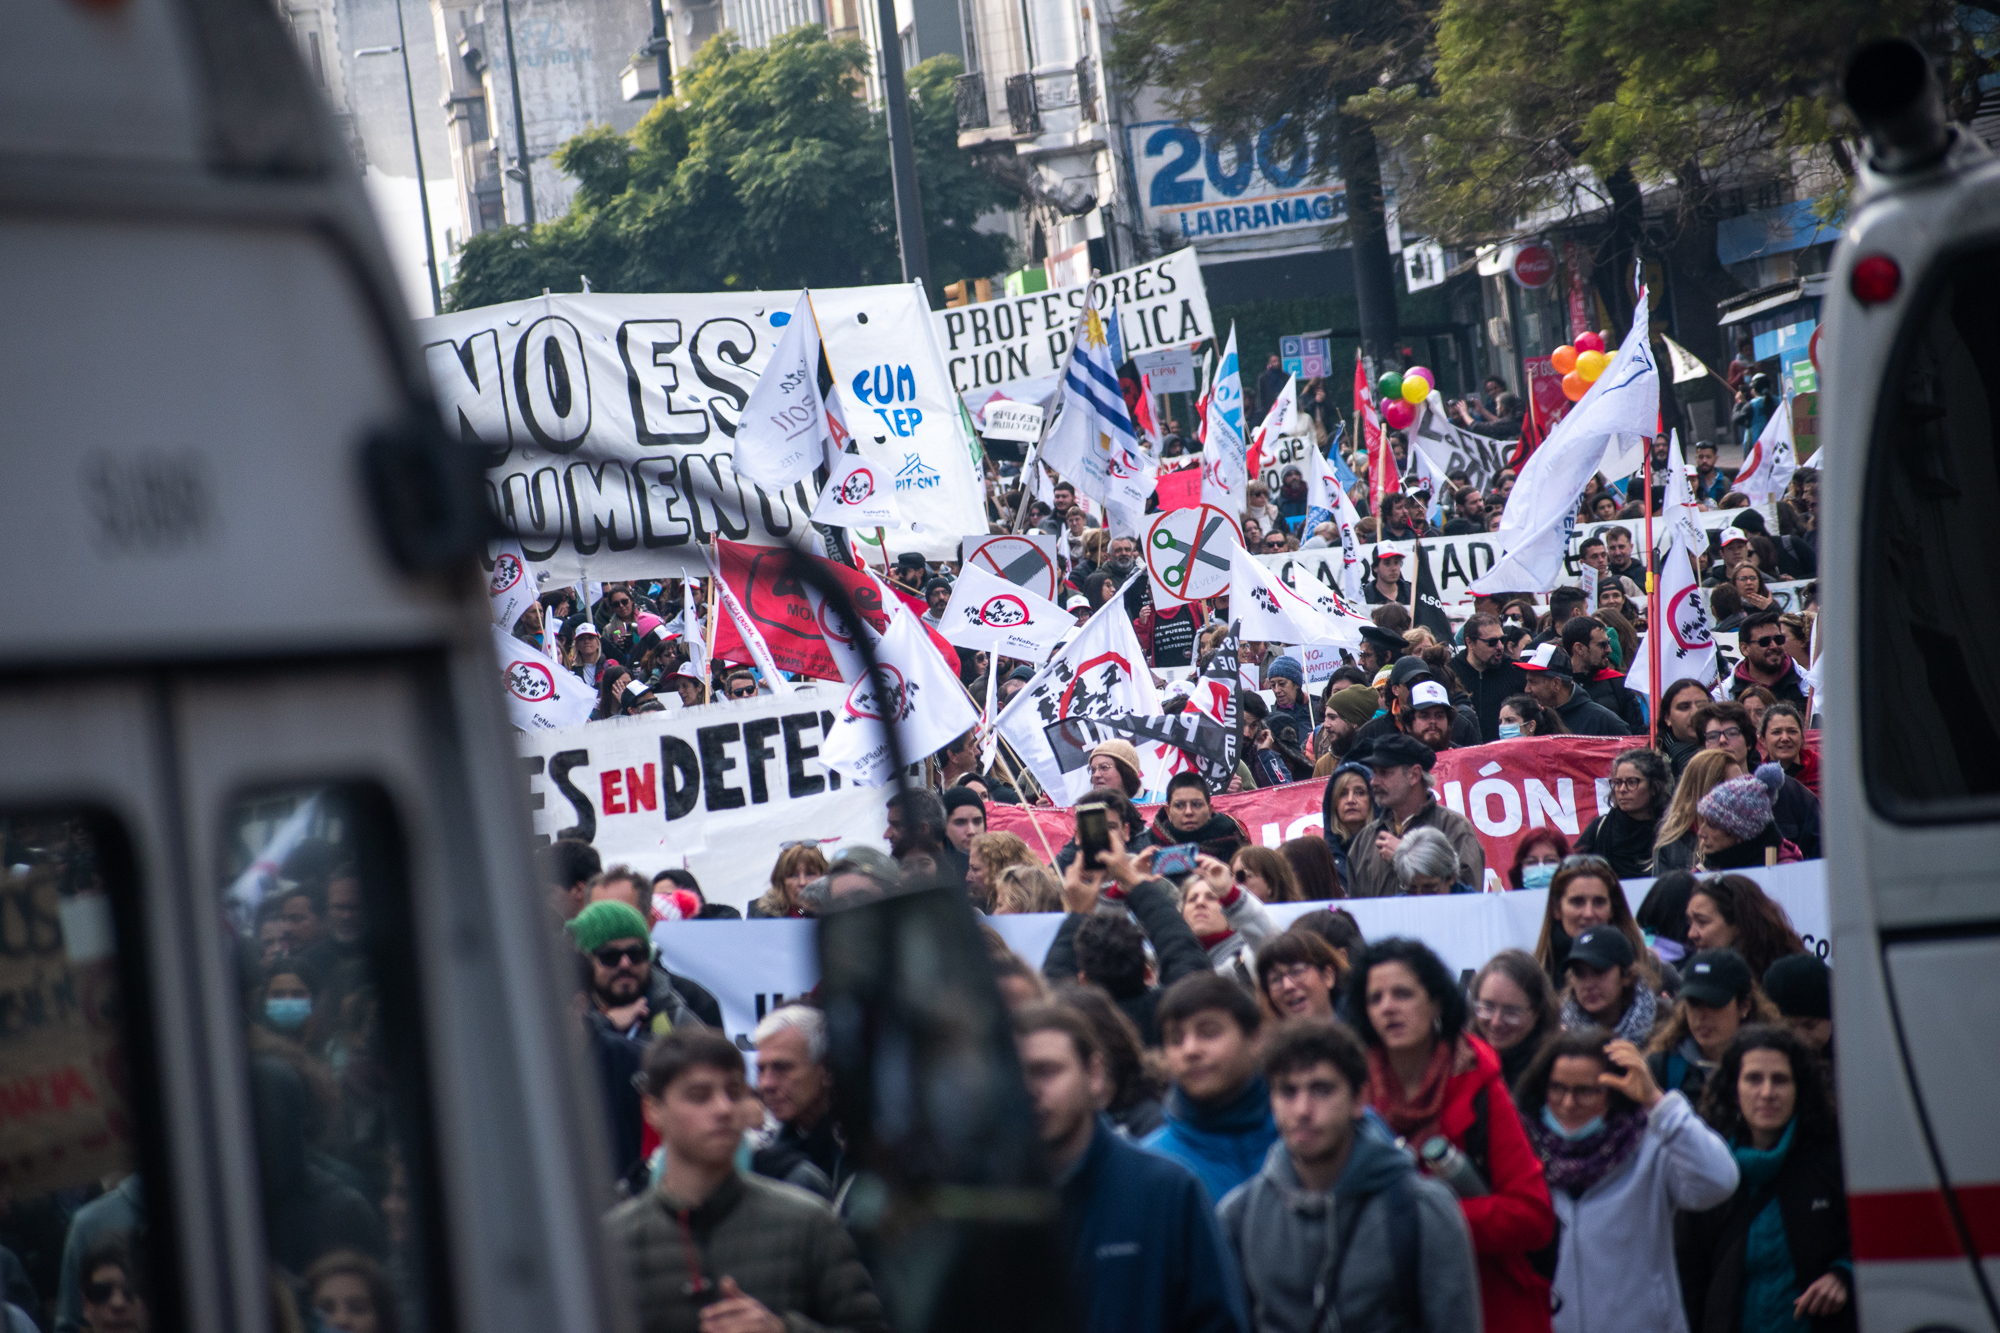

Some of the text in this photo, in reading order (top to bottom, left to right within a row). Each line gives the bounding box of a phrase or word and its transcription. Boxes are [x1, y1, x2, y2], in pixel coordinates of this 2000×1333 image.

[944, 260, 1177, 351] PROFESORES
[425, 314, 761, 468] NO ES
[873, 408, 923, 437] TEP
[895, 475, 941, 491] PIT-CNT
[1189, 573, 1222, 591] RIVERA
[1165, 626, 1192, 635] PUEBLO
[1171, 634, 1193, 642] VENDE
[600, 762, 657, 816] EN
